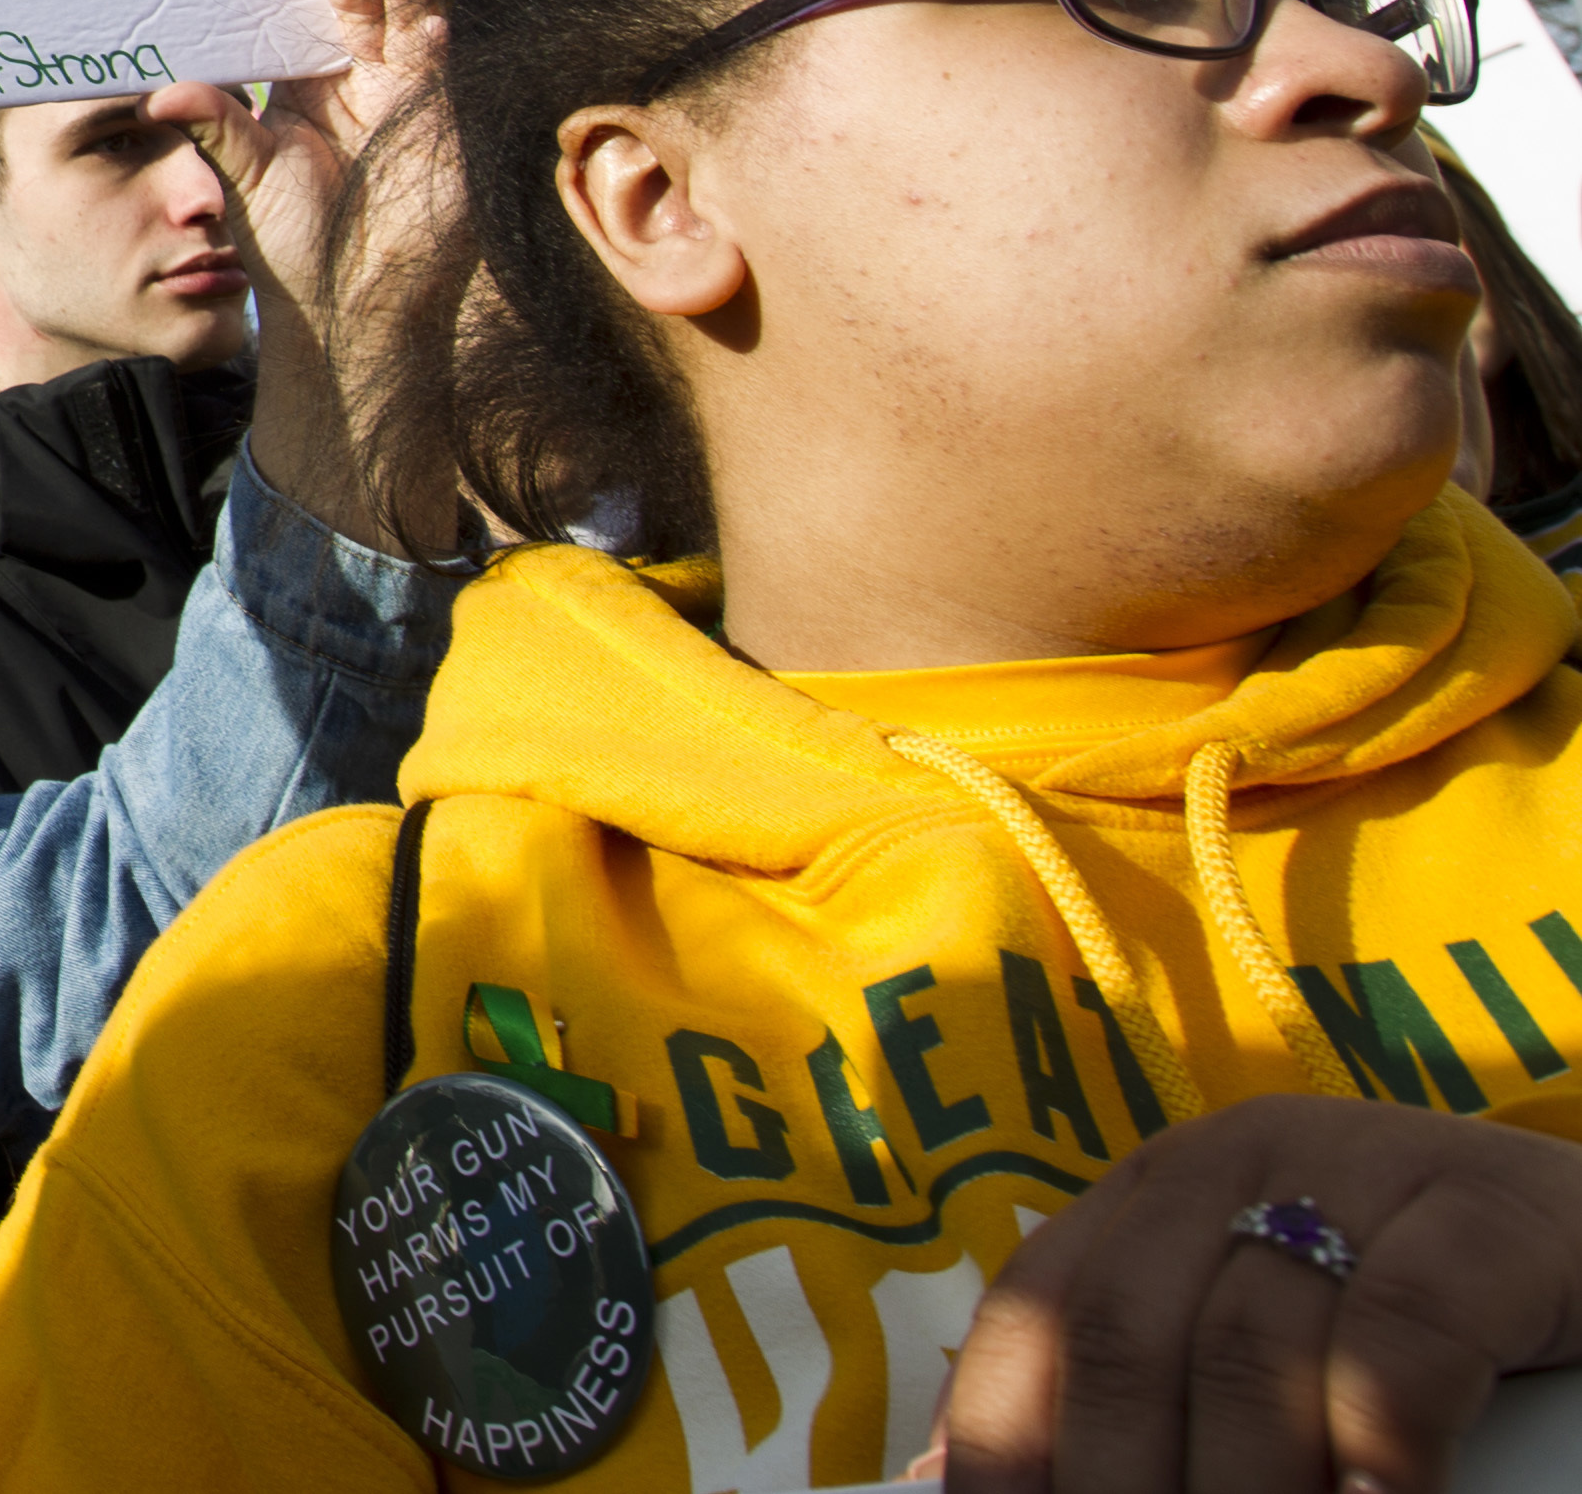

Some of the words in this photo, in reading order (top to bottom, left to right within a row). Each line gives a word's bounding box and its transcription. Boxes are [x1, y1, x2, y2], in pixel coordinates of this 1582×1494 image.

[336, 1162, 443, 1247] YOUR
[450, 1104, 540, 1176] GUN
[358, 1199, 491, 1301] HARMS
[497, 1154, 558, 1217] MY
[367, 1239, 531, 1364] PURSUIT
[545, 1200, 604, 1257] OF
[421, 1297, 636, 1466] HAPPINESS
